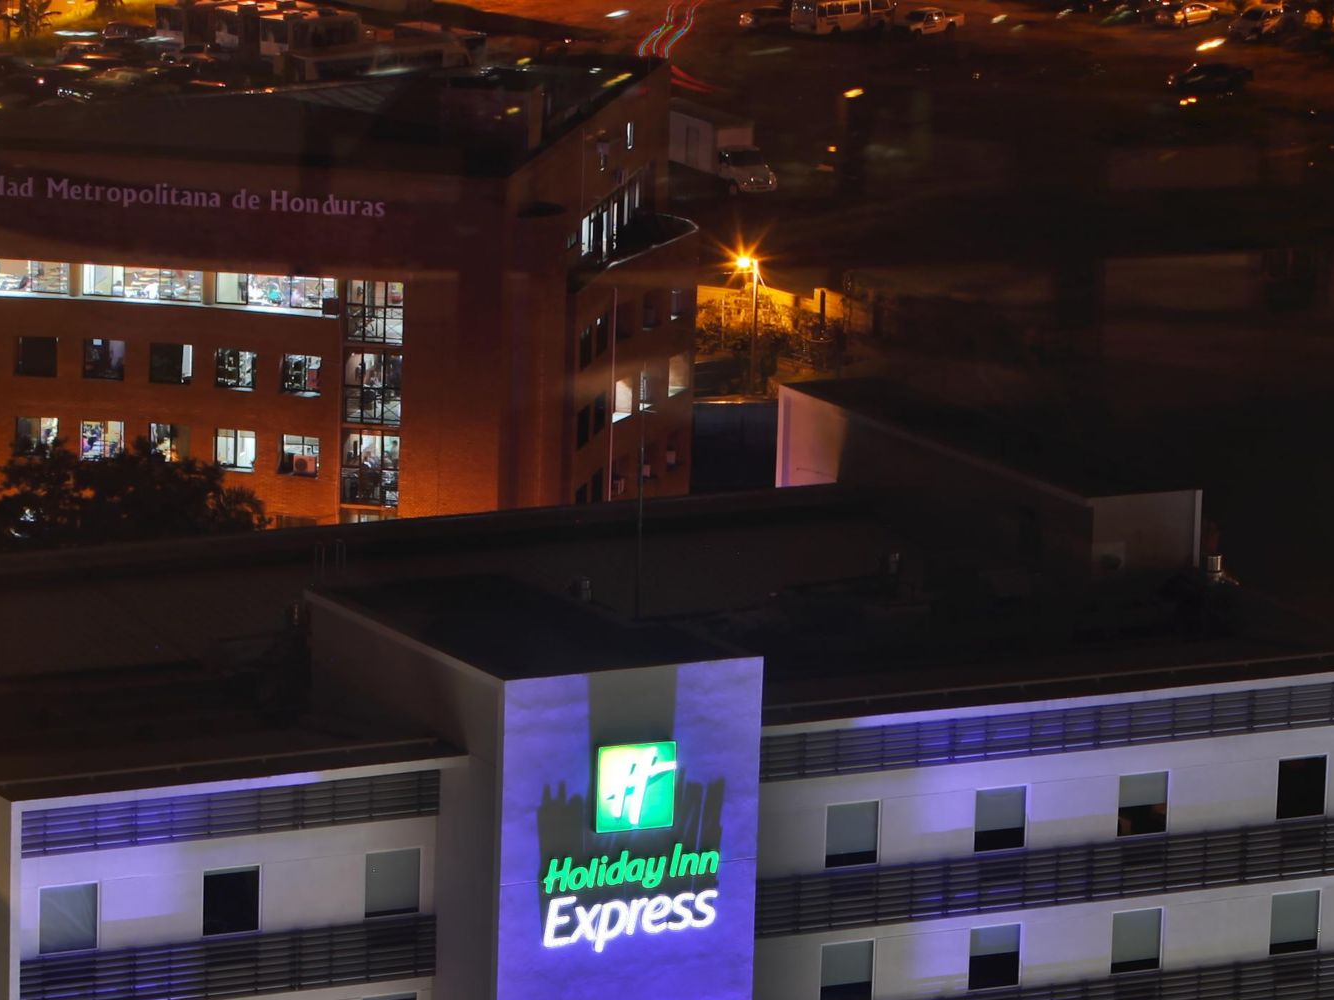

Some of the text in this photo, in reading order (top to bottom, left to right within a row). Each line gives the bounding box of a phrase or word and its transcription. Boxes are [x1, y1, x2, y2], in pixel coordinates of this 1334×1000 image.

[47, 177, 222, 207] Metropolitana
[231, 188, 260, 210] de
[270, 190, 386, 218] Honduras
[543, 844, 720, 894] Holiday Inn
[542, 889, 719, 953] Express
